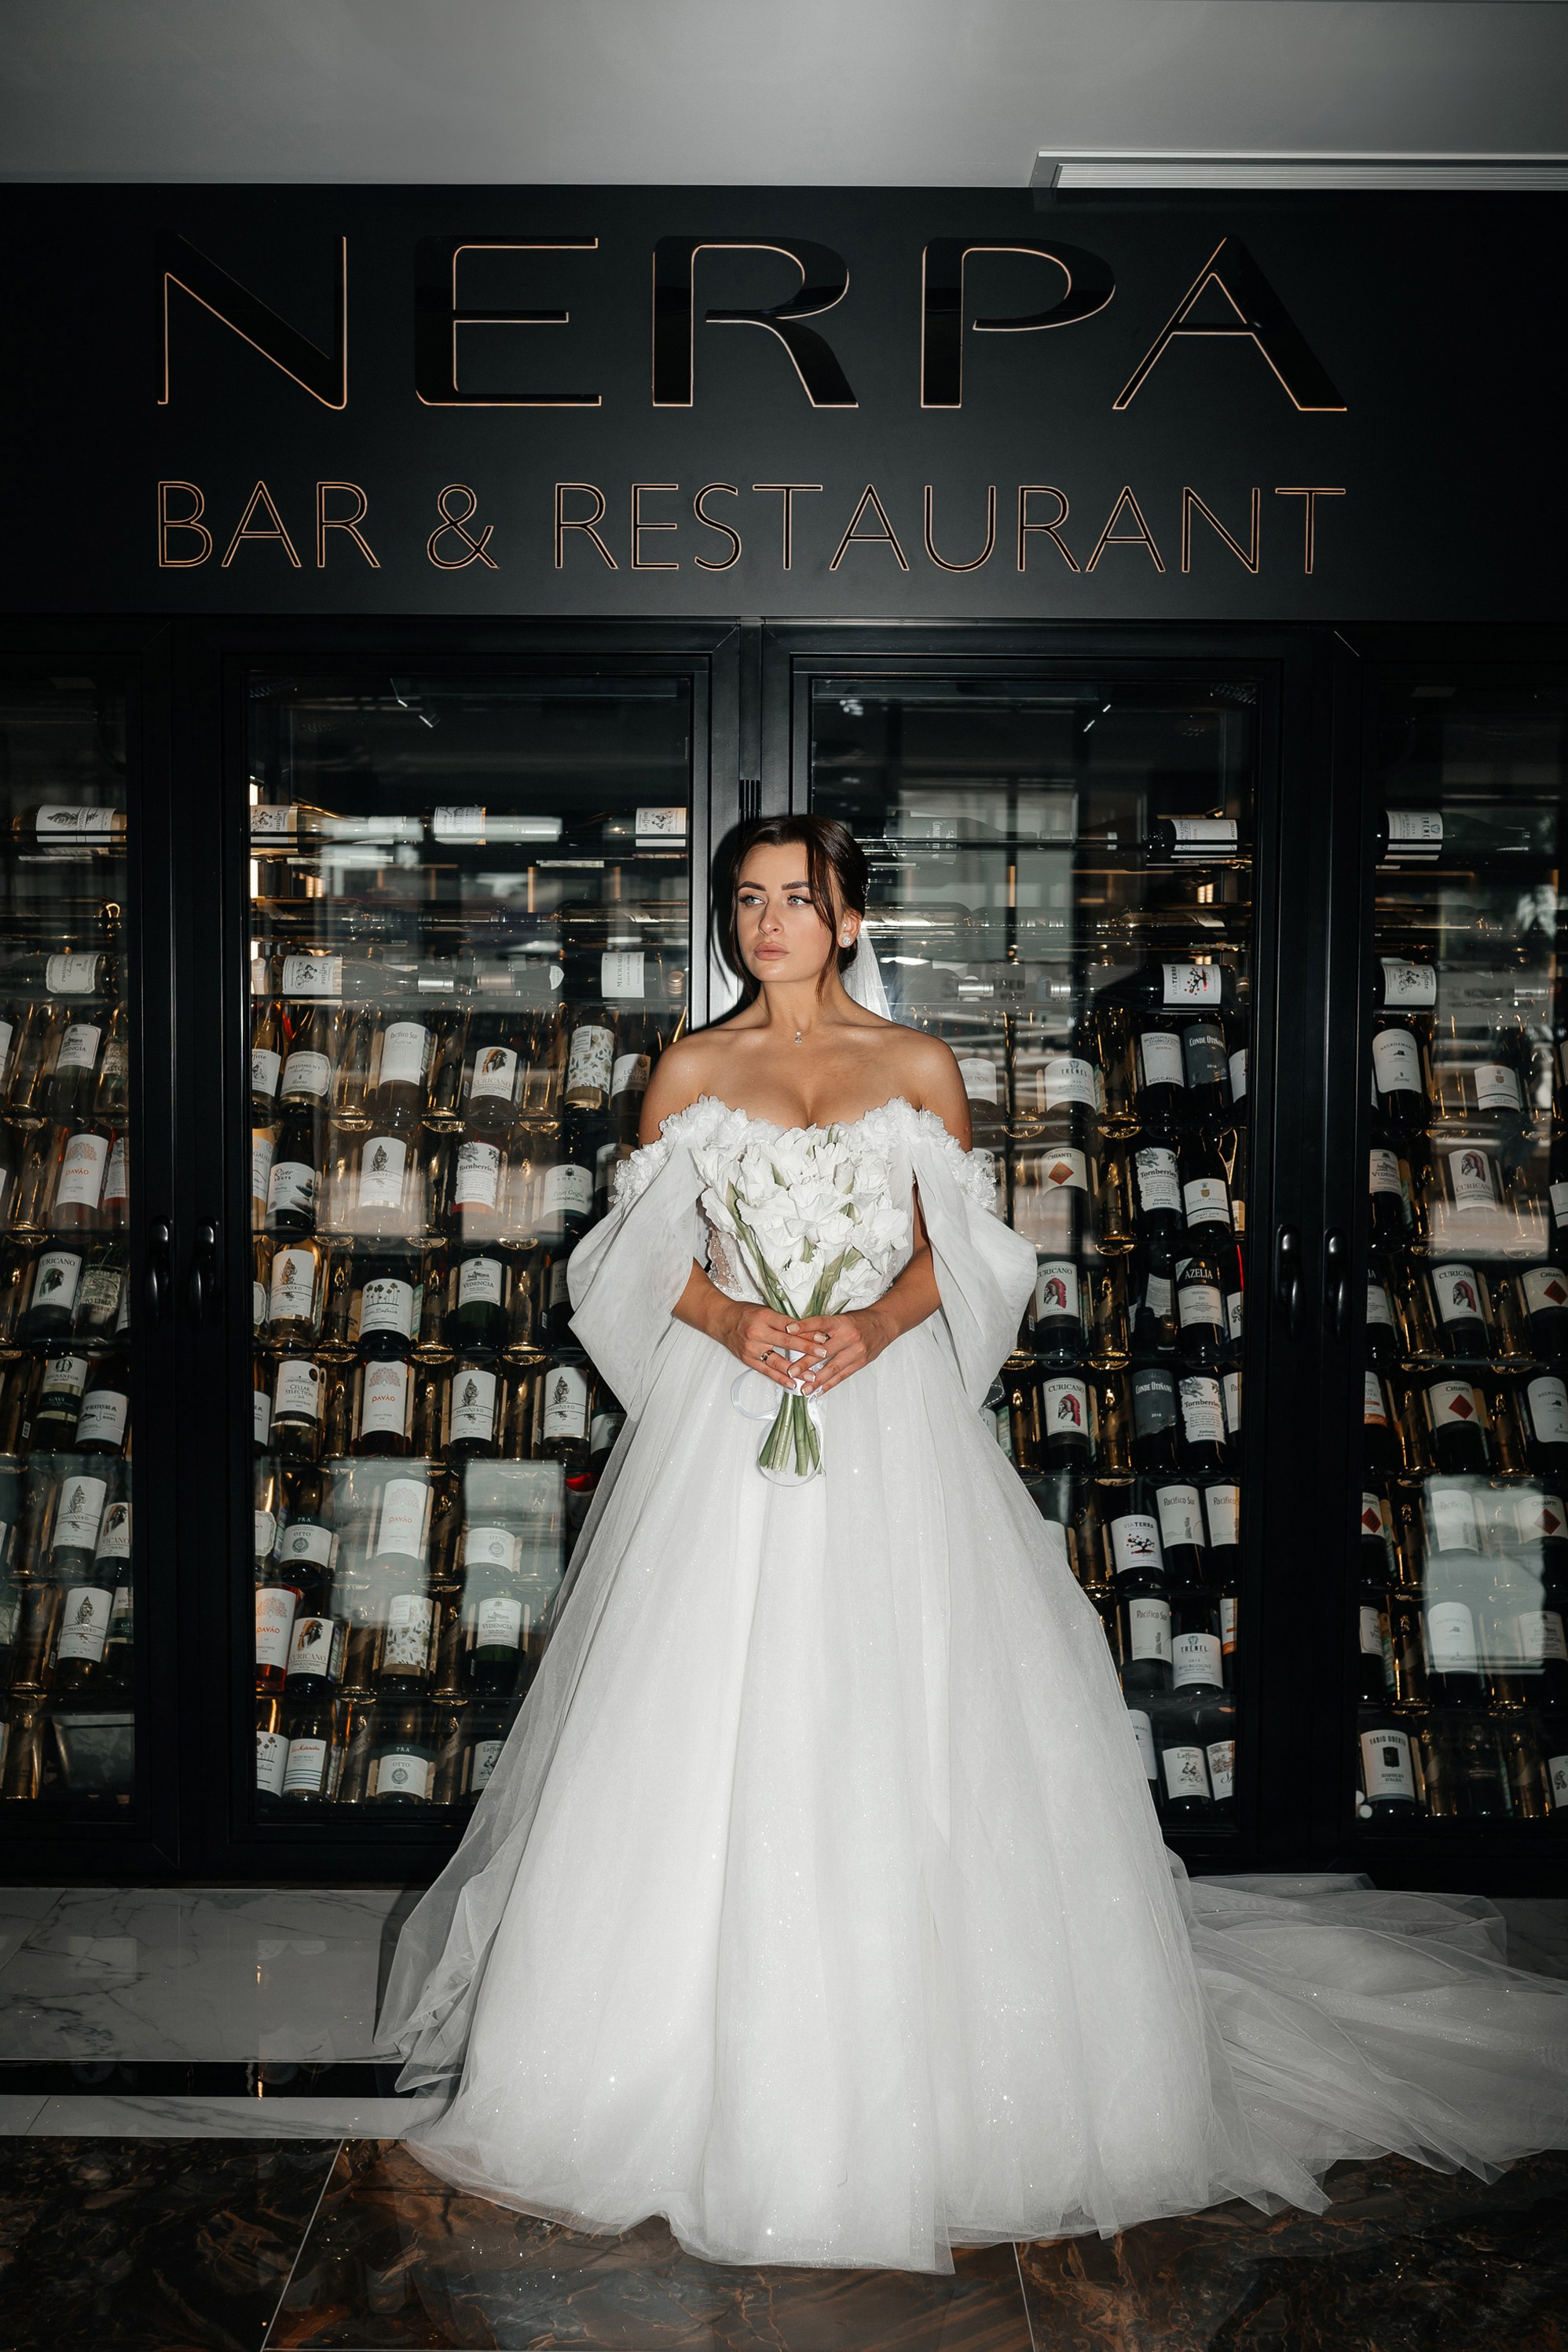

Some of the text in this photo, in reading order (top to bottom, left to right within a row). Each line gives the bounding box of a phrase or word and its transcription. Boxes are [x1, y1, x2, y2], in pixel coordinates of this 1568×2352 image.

[157, 233, 1348, 412] NERPA
[158, 480, 1346, 574] BAR & RESTAURANT
[273, 810, 284, 831] Laffitte
[641, 811, 650, 832] Laffitte
[318, 962, 329, 986] Laffitte
[1420, 969, 1431, 991] Laffitte
[1189, 1038, 1207, 1046] CONDE
[623, 1068, 647, 1077] LOUIS
[1149, 1076, 1184, 1085] BOCCANTINO
[1140, 1168, 1178, 1178] Tornberries
[1185, 1268, 1213, 1280] AZELIA
[463, 1280, 494, 1289] VIDENCIA
[1048, 1383, 1085, 1394] CURICANO
[1136, 1383, 1151, 1394] CONDE
[372, 1394, 396, 1404] PAVÃO
[1185, 1399, 1221, 1409] Tornberries
[1163, 1497, 1187, 1507] Pacifico
[389, 1515, 413, 1524] PAVÃO
[1123, 1521, 1155, 1530] VIATERRA
[489, 1534, 507, 1543] OTTO
[1137, 1610, 1159, 1619] Pacifico
[256, 1625, 280, 1635] PAVÃO
[1369, 1735, 1387, 1746] FABIO
[1177, 1752, 1199, 1761] Laffitte
